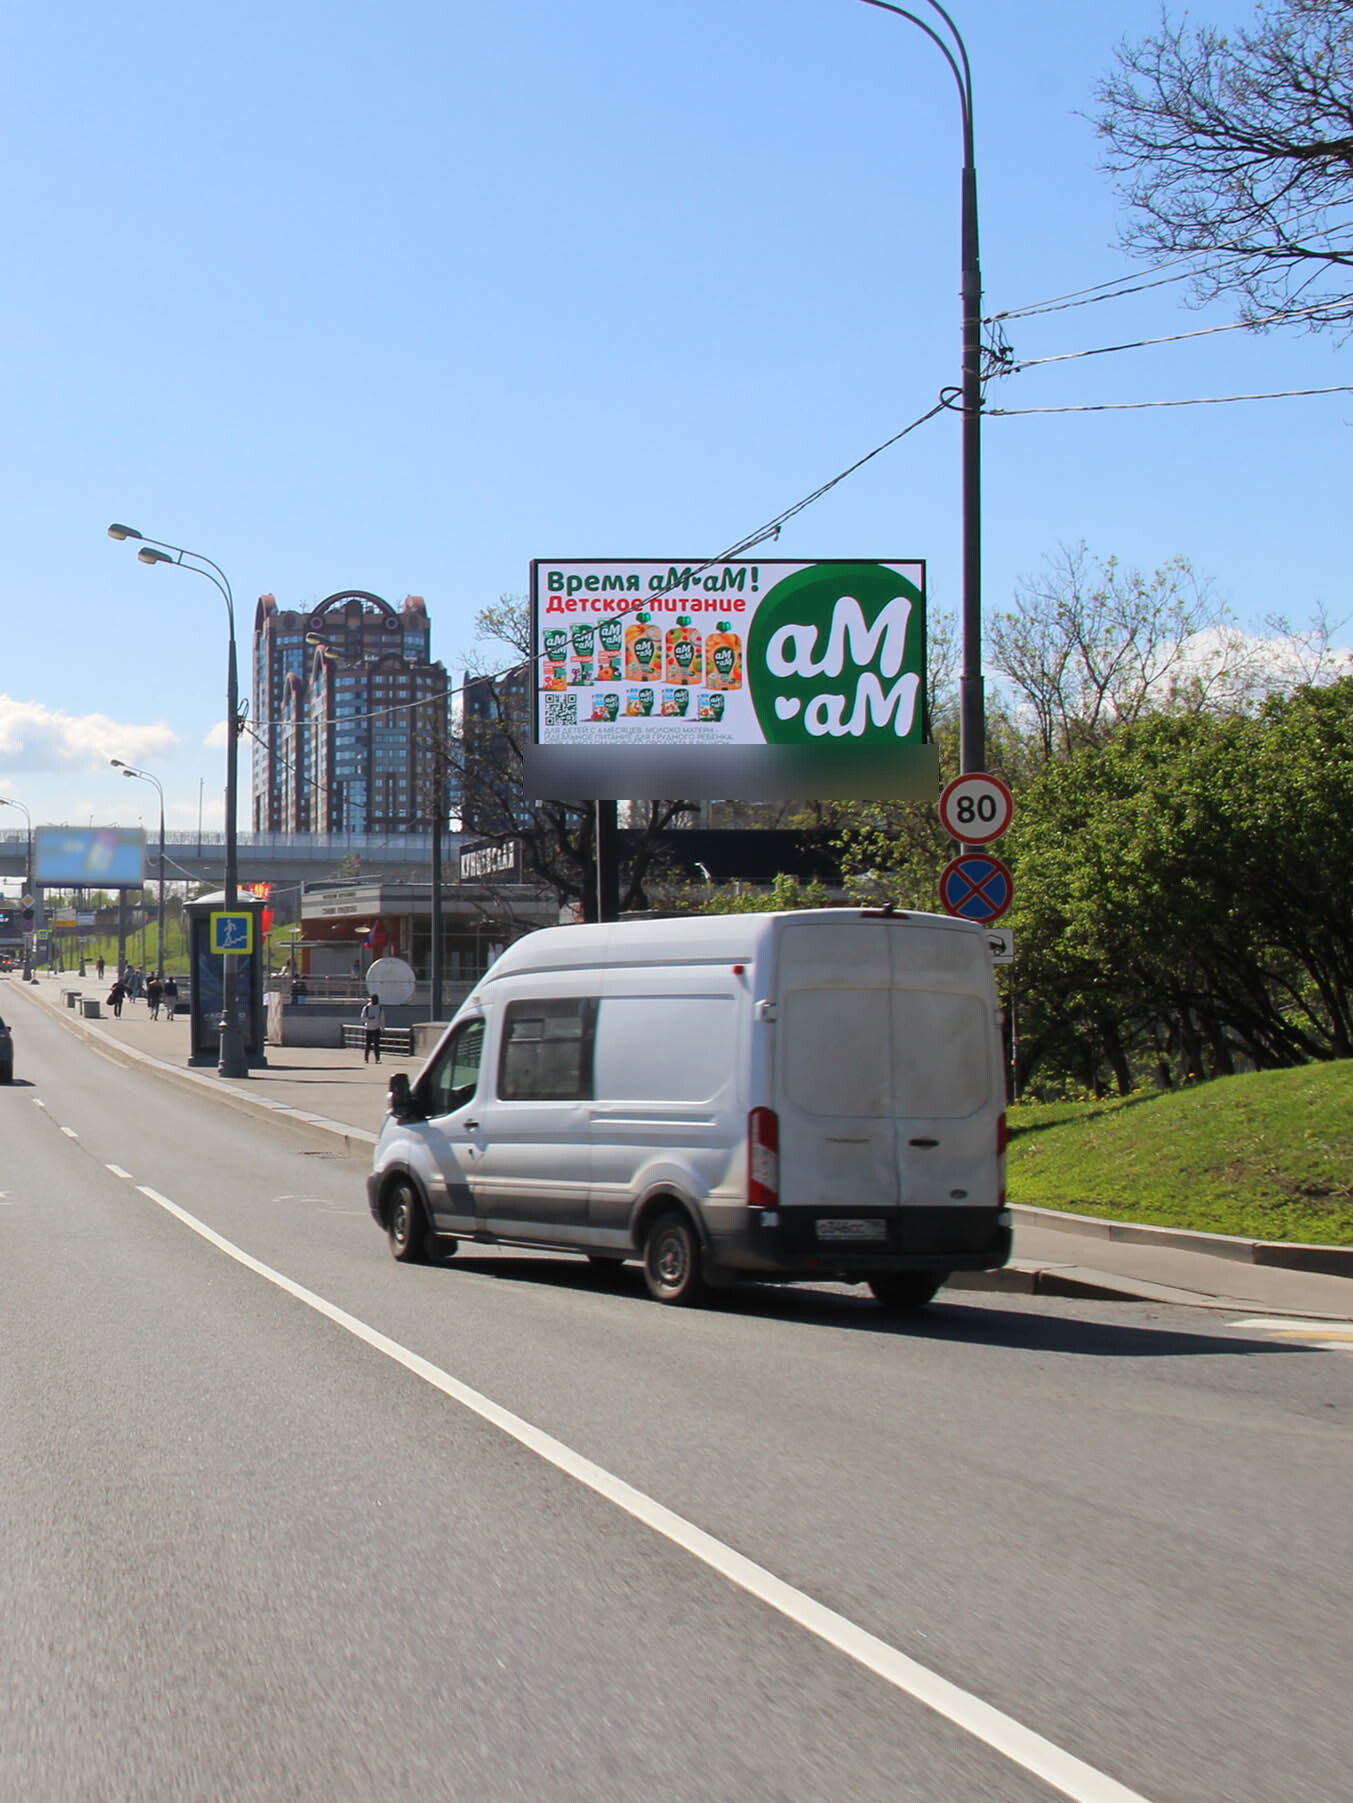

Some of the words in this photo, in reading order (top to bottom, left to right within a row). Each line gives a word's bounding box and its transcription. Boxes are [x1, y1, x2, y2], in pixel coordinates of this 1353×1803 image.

[547, 571, 640, 596] Время
[546, 596, 643, 613] Детское
[650, 598, 746, 612] питание
[957, 794, 996, 823] 80
